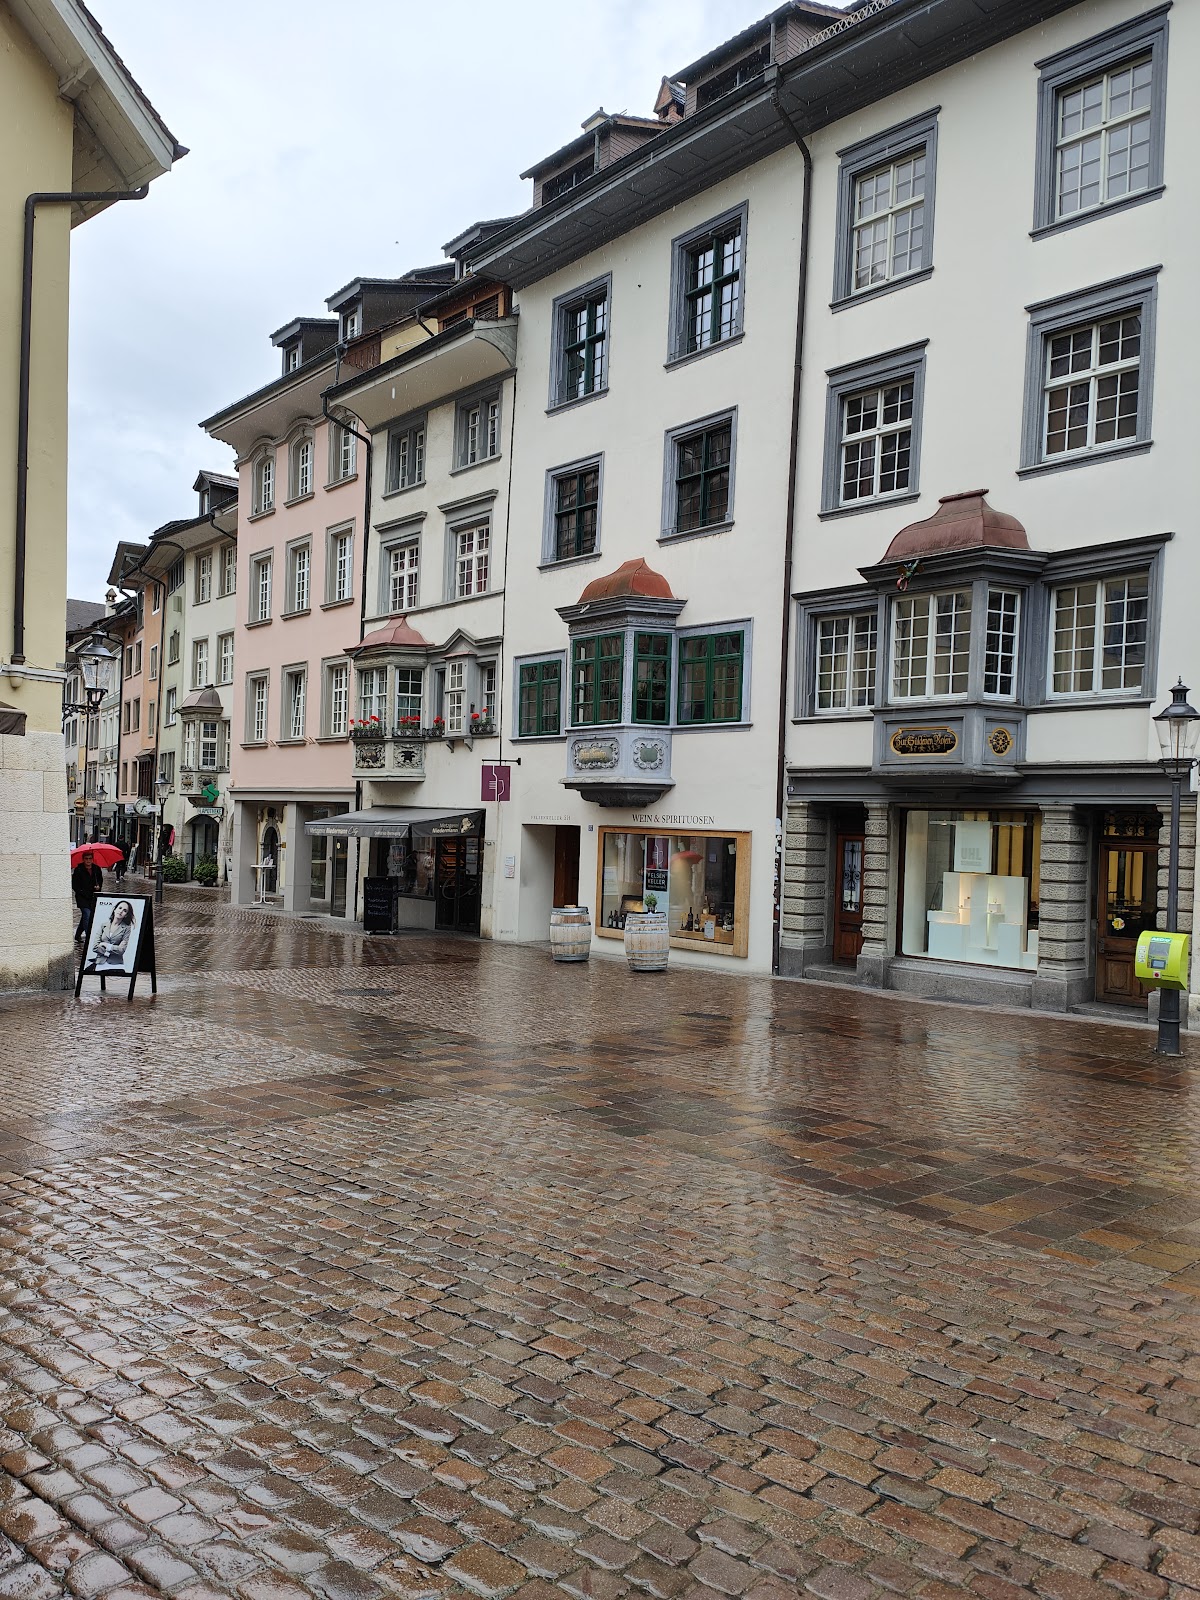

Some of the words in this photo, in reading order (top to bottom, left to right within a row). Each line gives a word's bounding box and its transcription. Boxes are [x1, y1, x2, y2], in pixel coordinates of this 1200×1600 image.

[632, 813, 653, 823] WEIN
[653, 815, 660, 823] &
[661, 814, 715, 825] SPIRITUOSEN
